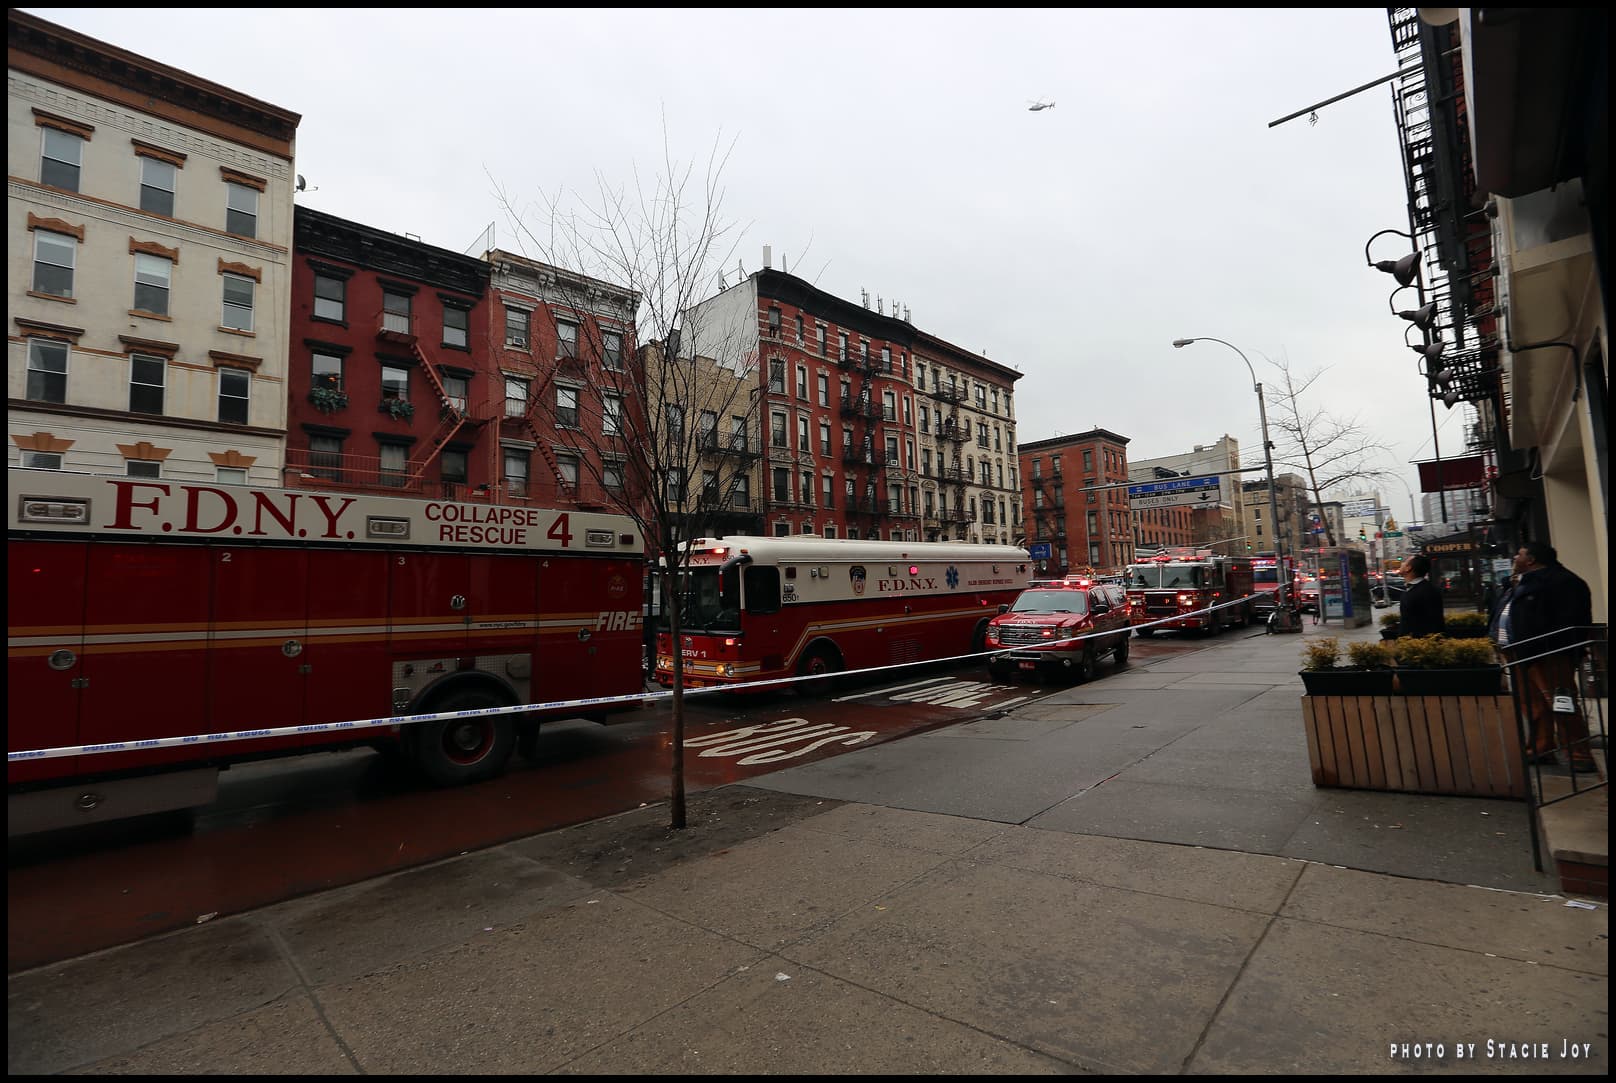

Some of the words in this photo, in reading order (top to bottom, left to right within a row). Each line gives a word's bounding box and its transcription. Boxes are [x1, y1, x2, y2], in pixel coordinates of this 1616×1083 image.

[1153, 483, 1168, 491] BUS
[1172, 481, 1192, 489] LANE
[1138, 497, 1160, 505] BUSES
[1162, 495, 1180, 503] ONLY
[103, 480, 357, 540] F.D.N.Y.
[425, 503, 539, 526] COLLAPSE
[439, 524, 527, 545] RESCUE
[547, 513, 573, 547] 4
[221, 552, 232, 562] 2
[398, 556, 406, 566] 3
[878, 578, 938, 593] F.D.N.Y.
[596, 611, 638, 632] FIRE
[682, 649, 699, 658] ERV
[701, 650, 707, 658] 1
[672, 717, 878, 766] BUS
